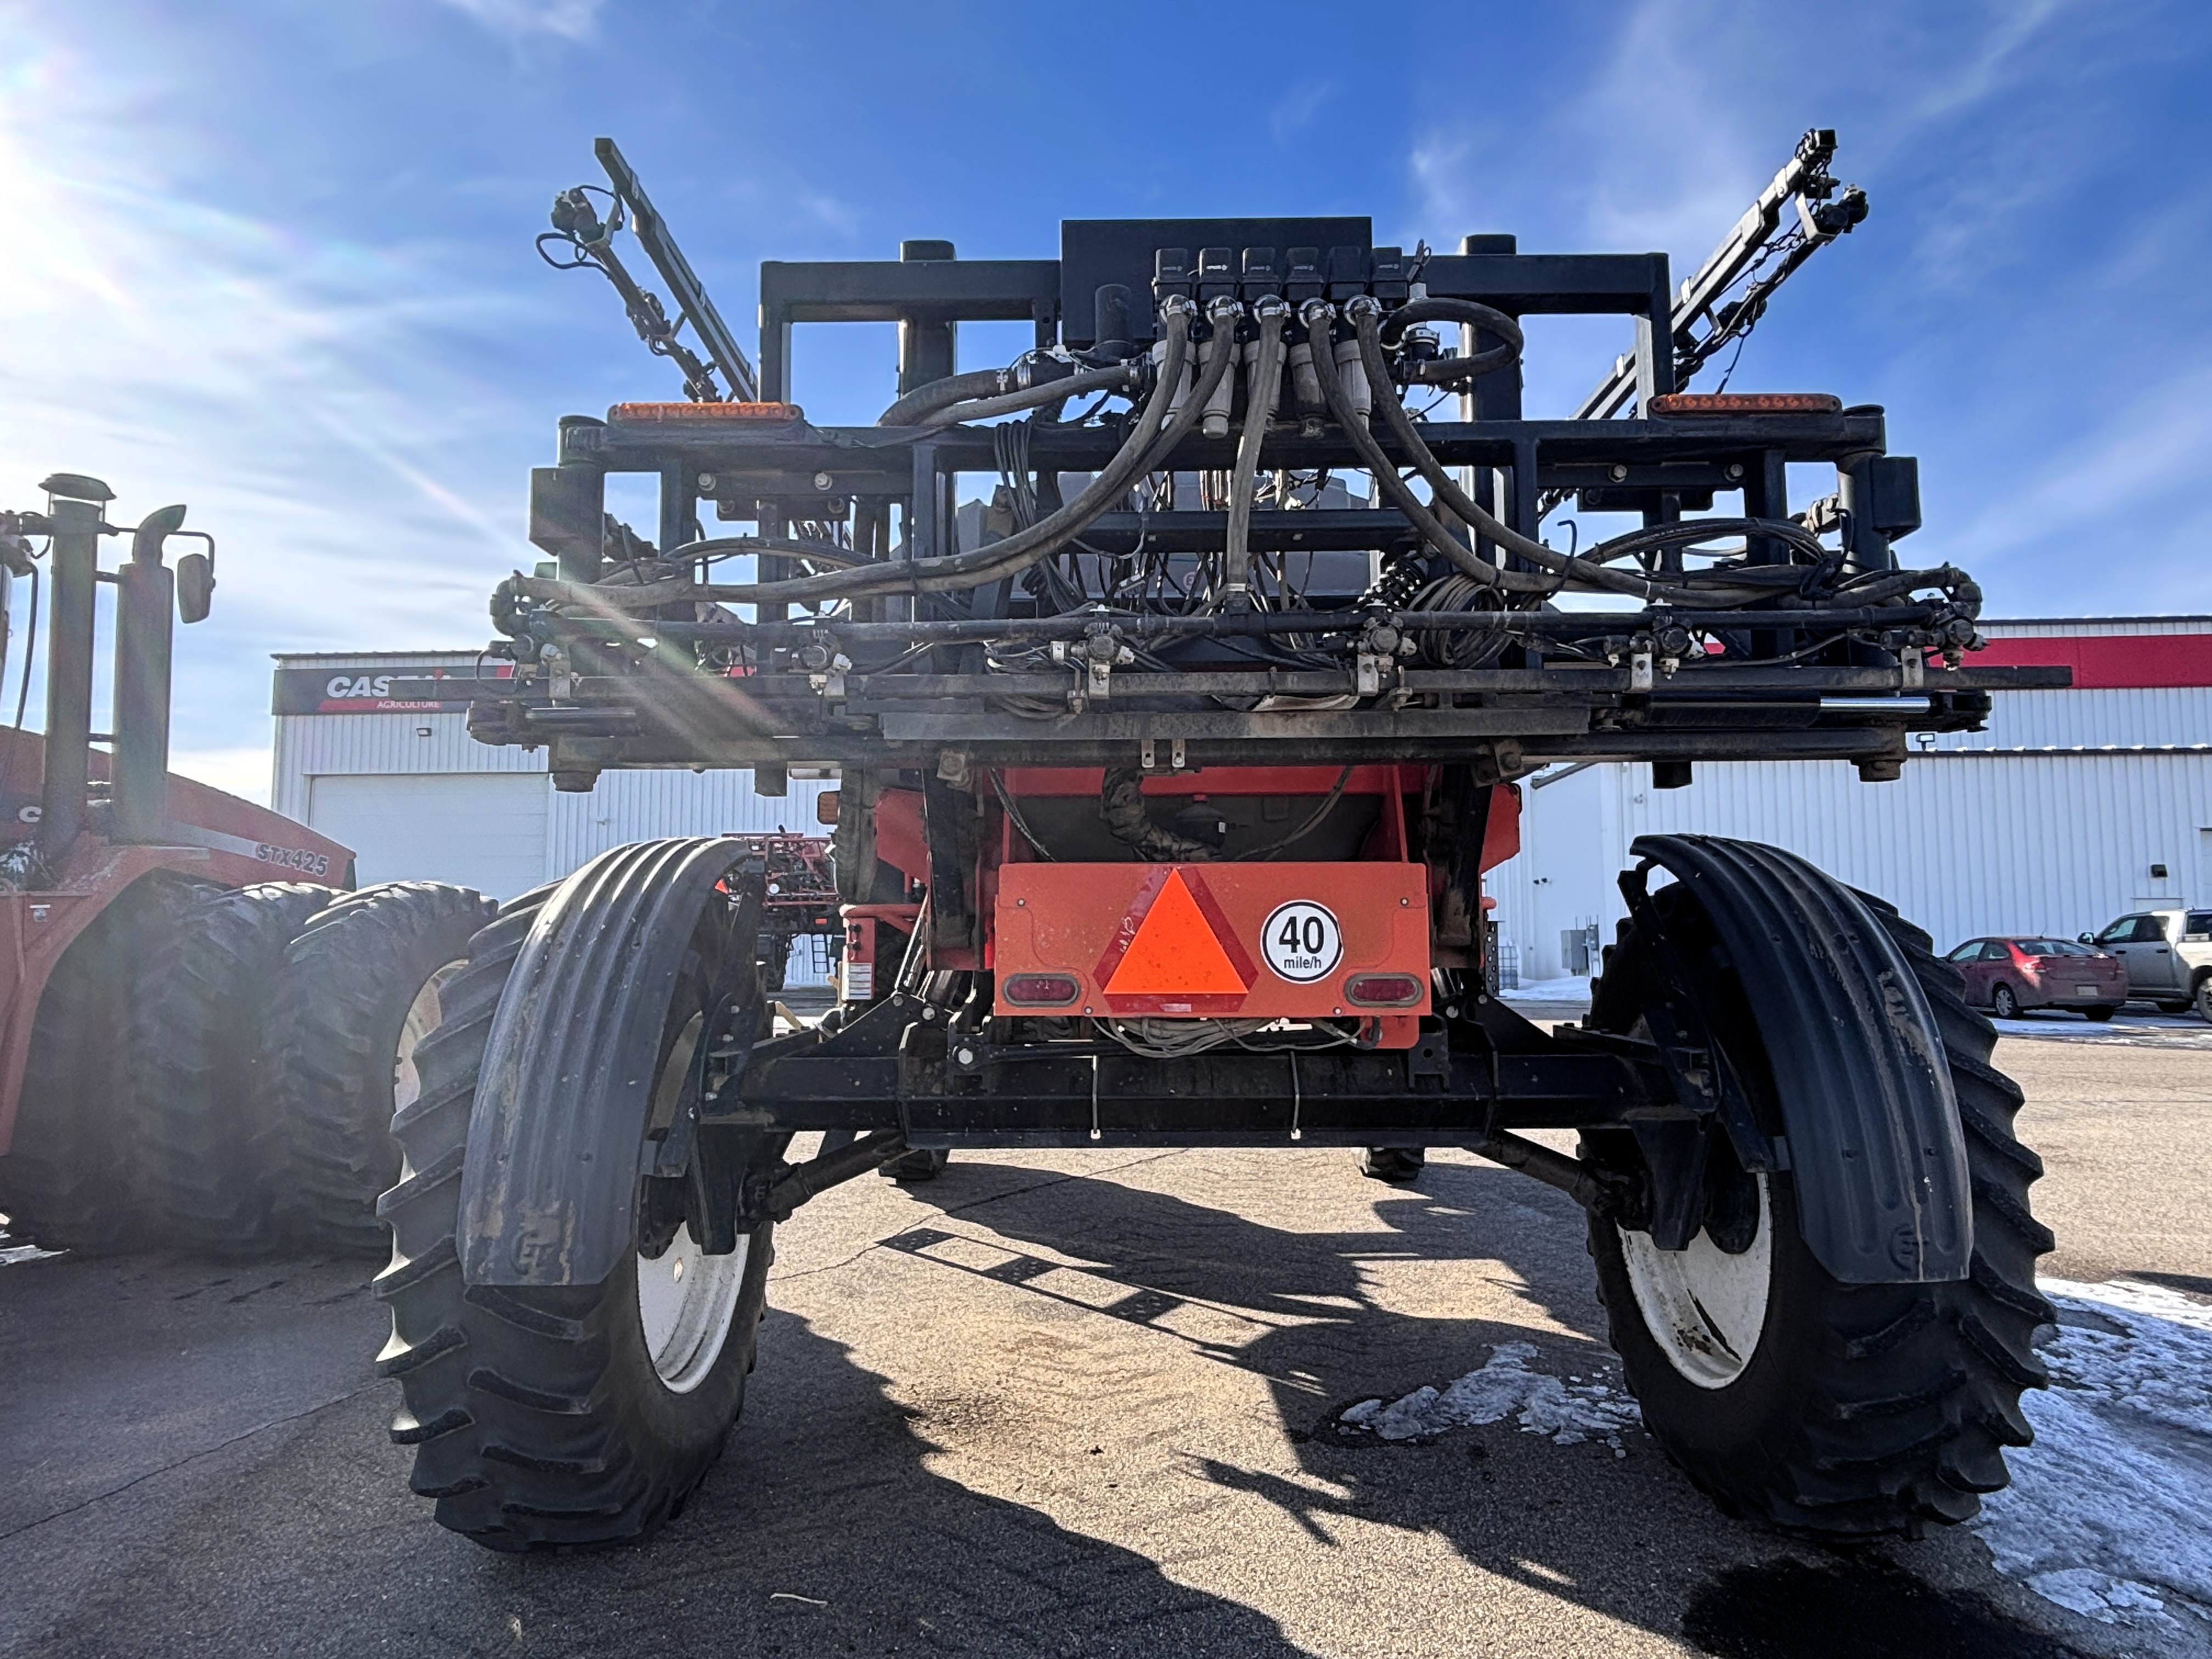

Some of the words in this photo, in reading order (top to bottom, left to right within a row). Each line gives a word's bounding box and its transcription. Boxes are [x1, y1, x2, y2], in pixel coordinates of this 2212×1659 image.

[326, 676, 418, 697] CAS
[257, 843, 329, 877] STX425
[1279, 916, 1324, 954] 40
[1284, 956, 1322, 969] mile/h
